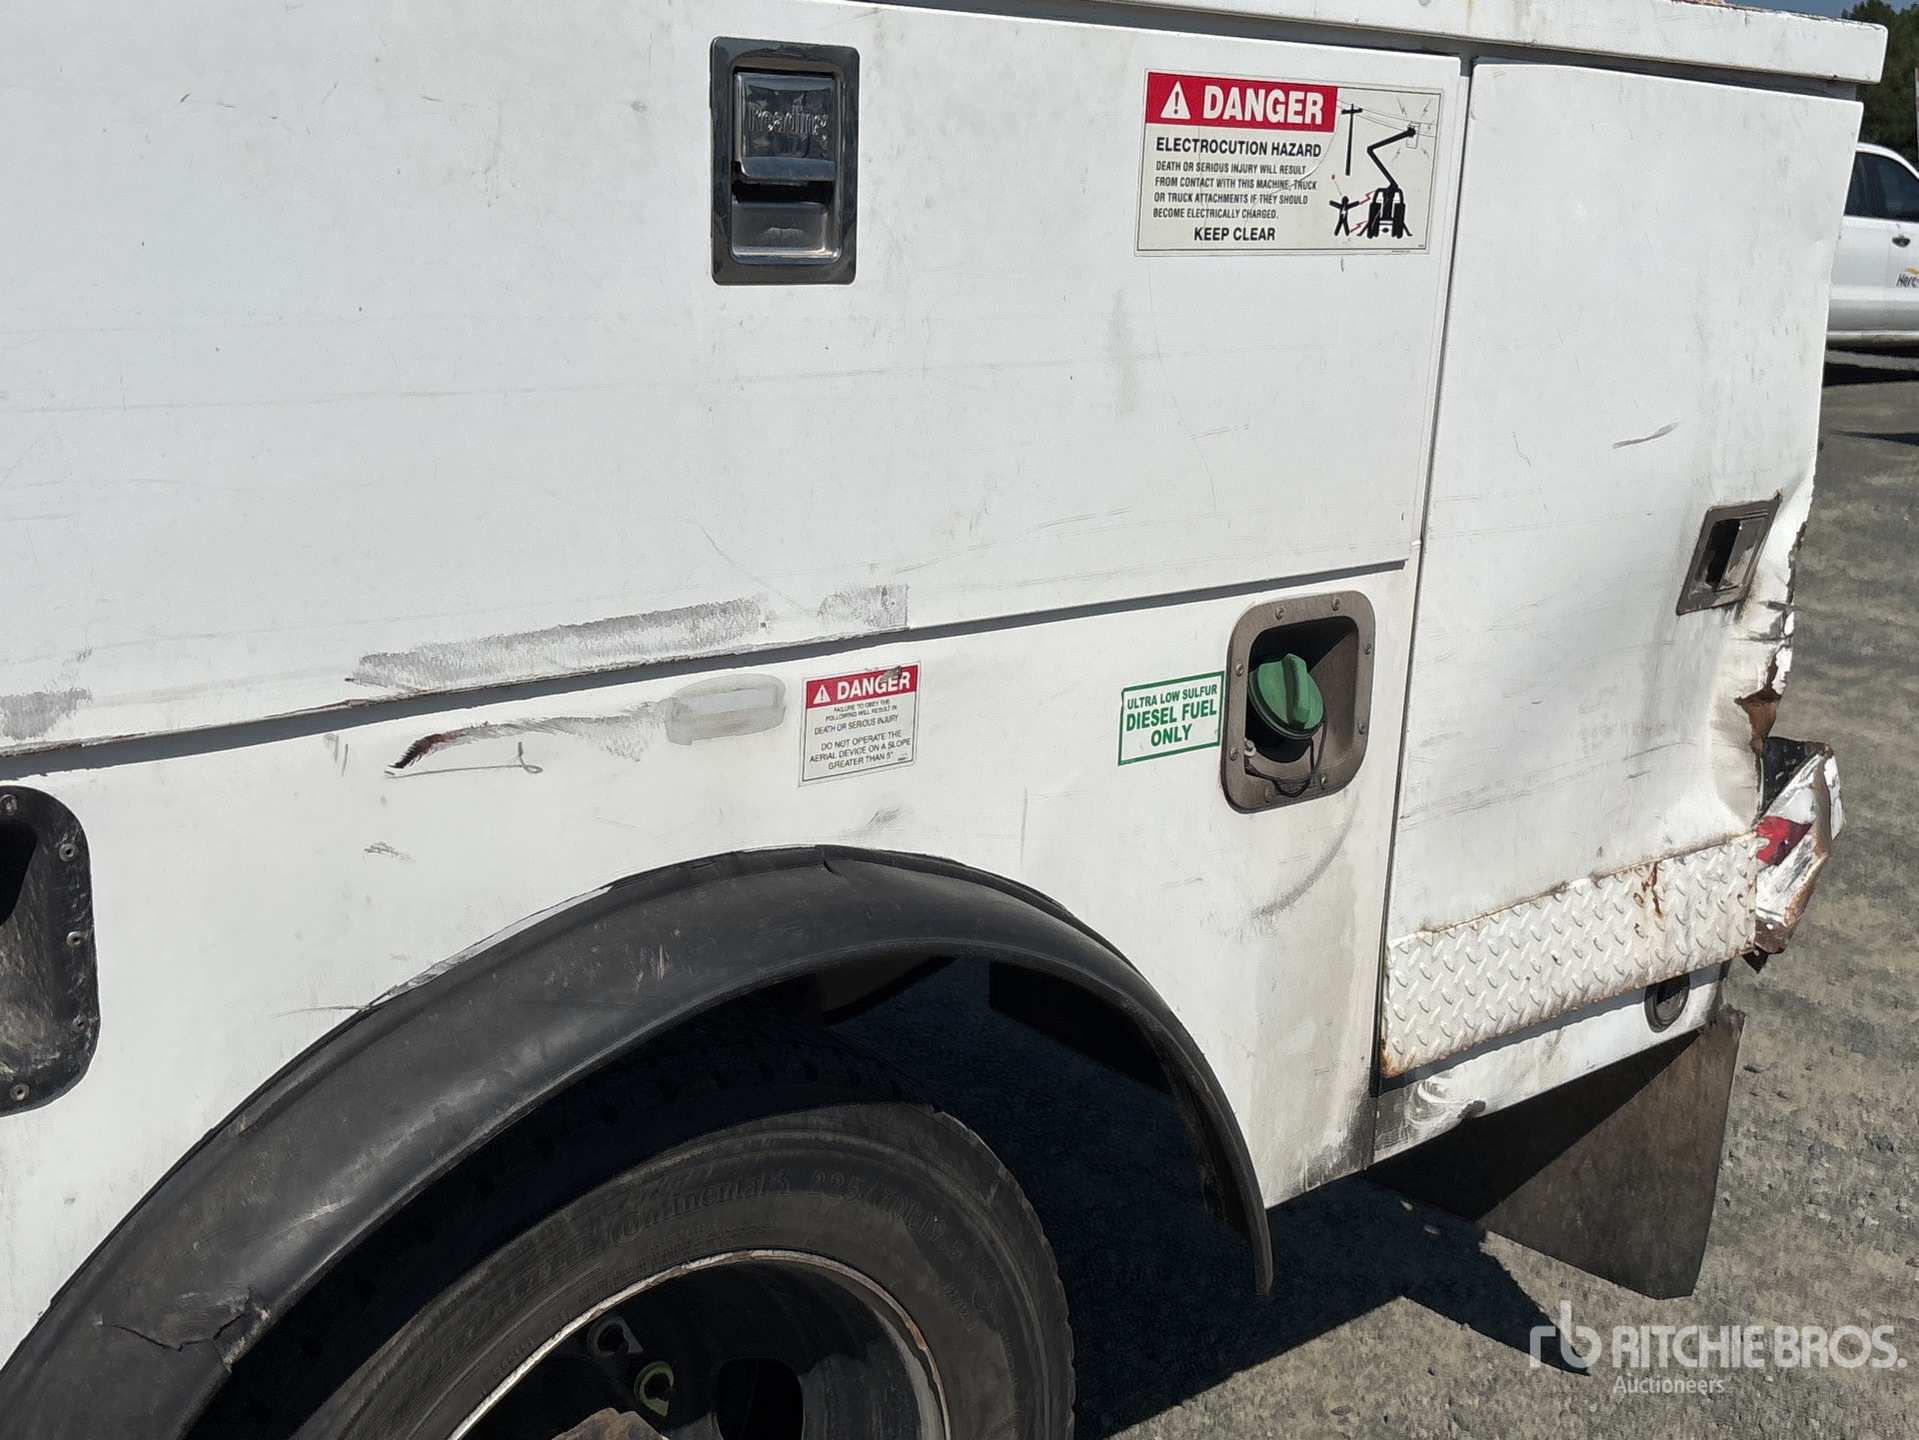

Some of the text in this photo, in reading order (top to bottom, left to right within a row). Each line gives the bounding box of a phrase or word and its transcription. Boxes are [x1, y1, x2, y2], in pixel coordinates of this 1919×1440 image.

[1203, 85, 1324, 124] DANGER
[748, 93, 829, 142] Reading
[1156, 137, 1321, 157] ELECTROCUTION HAZARD
[1156, 161, 1306, 175] DEATH OR SERIOUS INJURY WILL RESULT
[1155, 177, 1317, 191] FROM CONTACT WITH THIS MACHINE, TRUCK
[1154, 192, 1308, 205] OR TRUCK ATTACHMENTS IF THEY SHOULD
[1153, 208, 1278, 219] BECOME ELECTRICALLY CHARGED.
[1194, 227, 1276, 241] KEEP CLEAR
[837, 671, 911, 700] DANGER
[834, 704, 855, 712] FAILURE
[865, 701, 879, 709] OBEY
[1127, 684, 1218, 710] ULTRA LOW SULFUR
[826, 712, 857, 721] FOLLOWING
[872, 706, 890, 714] RESULT
[1126, 699, 1217, 732] DIESEL FUEL
[814, 714, 898, 735] DEATH OR SERIOUS INJURY
[1151, 723, 1192, 747] ONLY
[809, 751, 836, 763] AERIAL
[839, 746, 866, 758] DEVICE
[868, 744, 879, 752] ON
[888, 738, 911, 749] SLOPE
[821, 730, 902, 751] DO NOT OPERATE THE
[828, 757, 864, 770] GREATER
[866, 753, 885, 765] THAN
[610, 1169, 771, 1247] Continental
